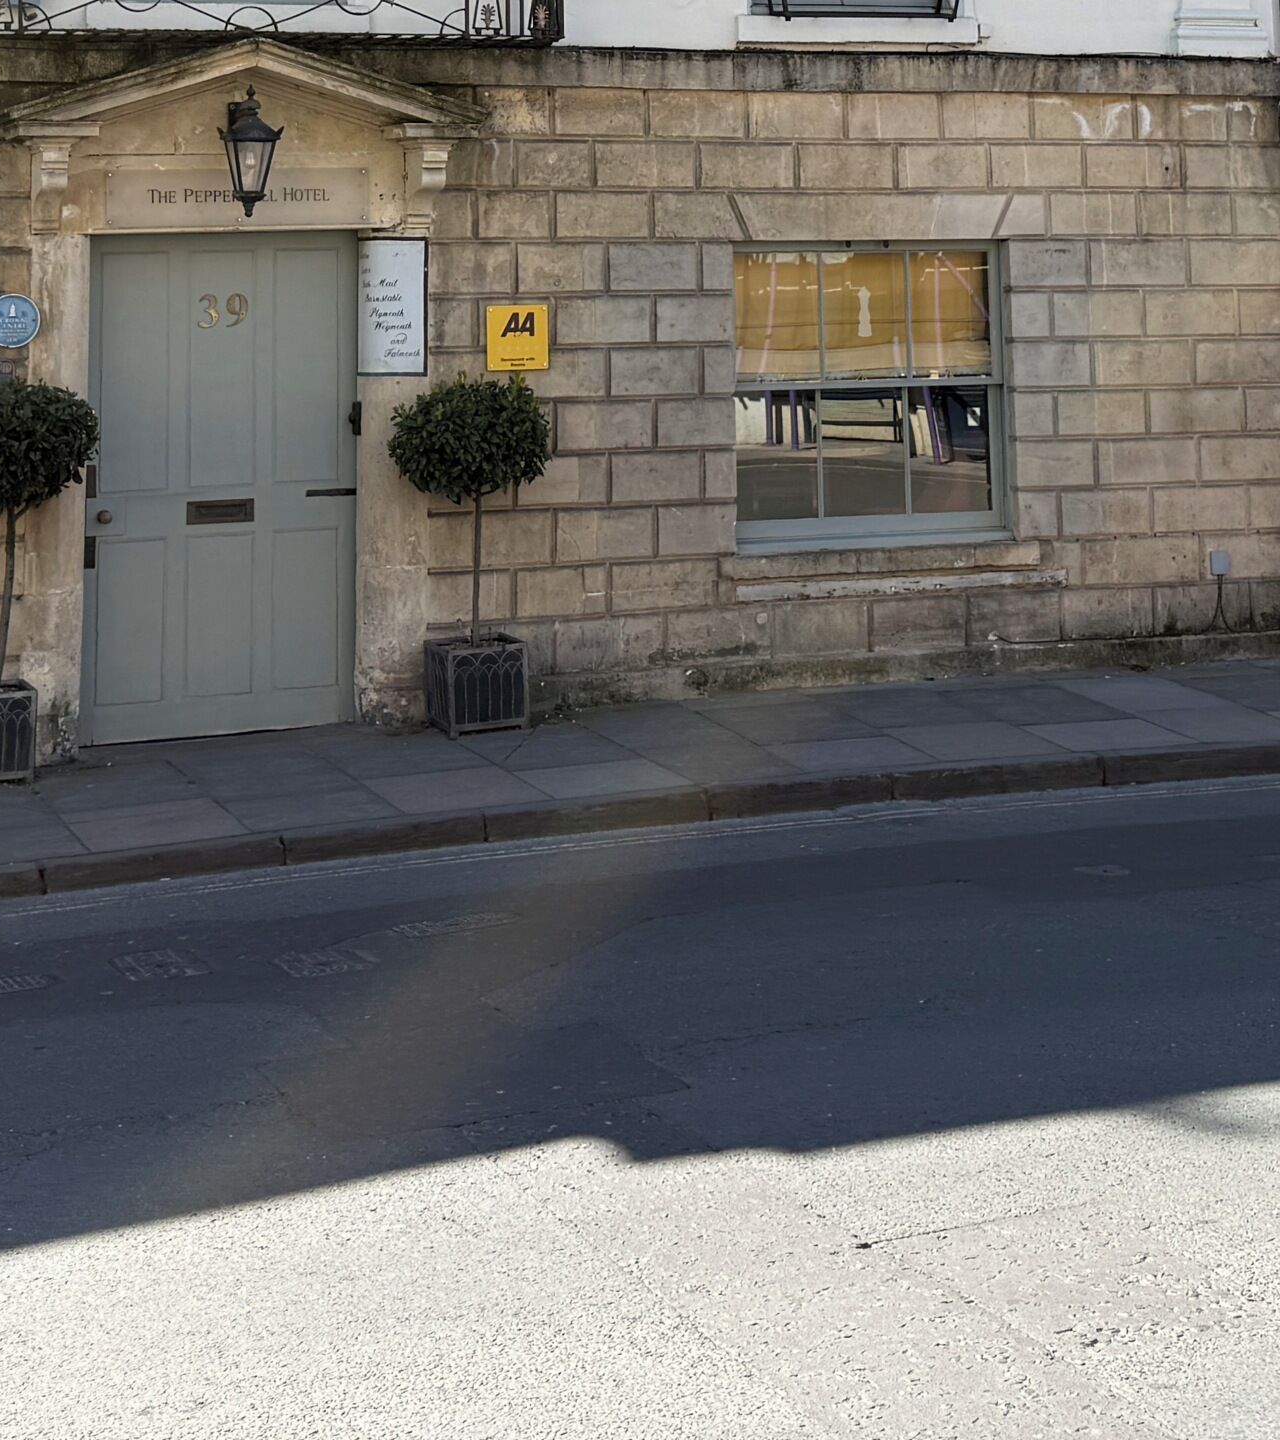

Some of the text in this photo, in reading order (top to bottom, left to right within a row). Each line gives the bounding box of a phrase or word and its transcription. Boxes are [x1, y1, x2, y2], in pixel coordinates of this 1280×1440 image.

[147, 188, 176, 204] THE
[283, 187, 330, 202] HOTEL
[197, 293, 249, 329] 39
[501, 312, 535, 337] AA
